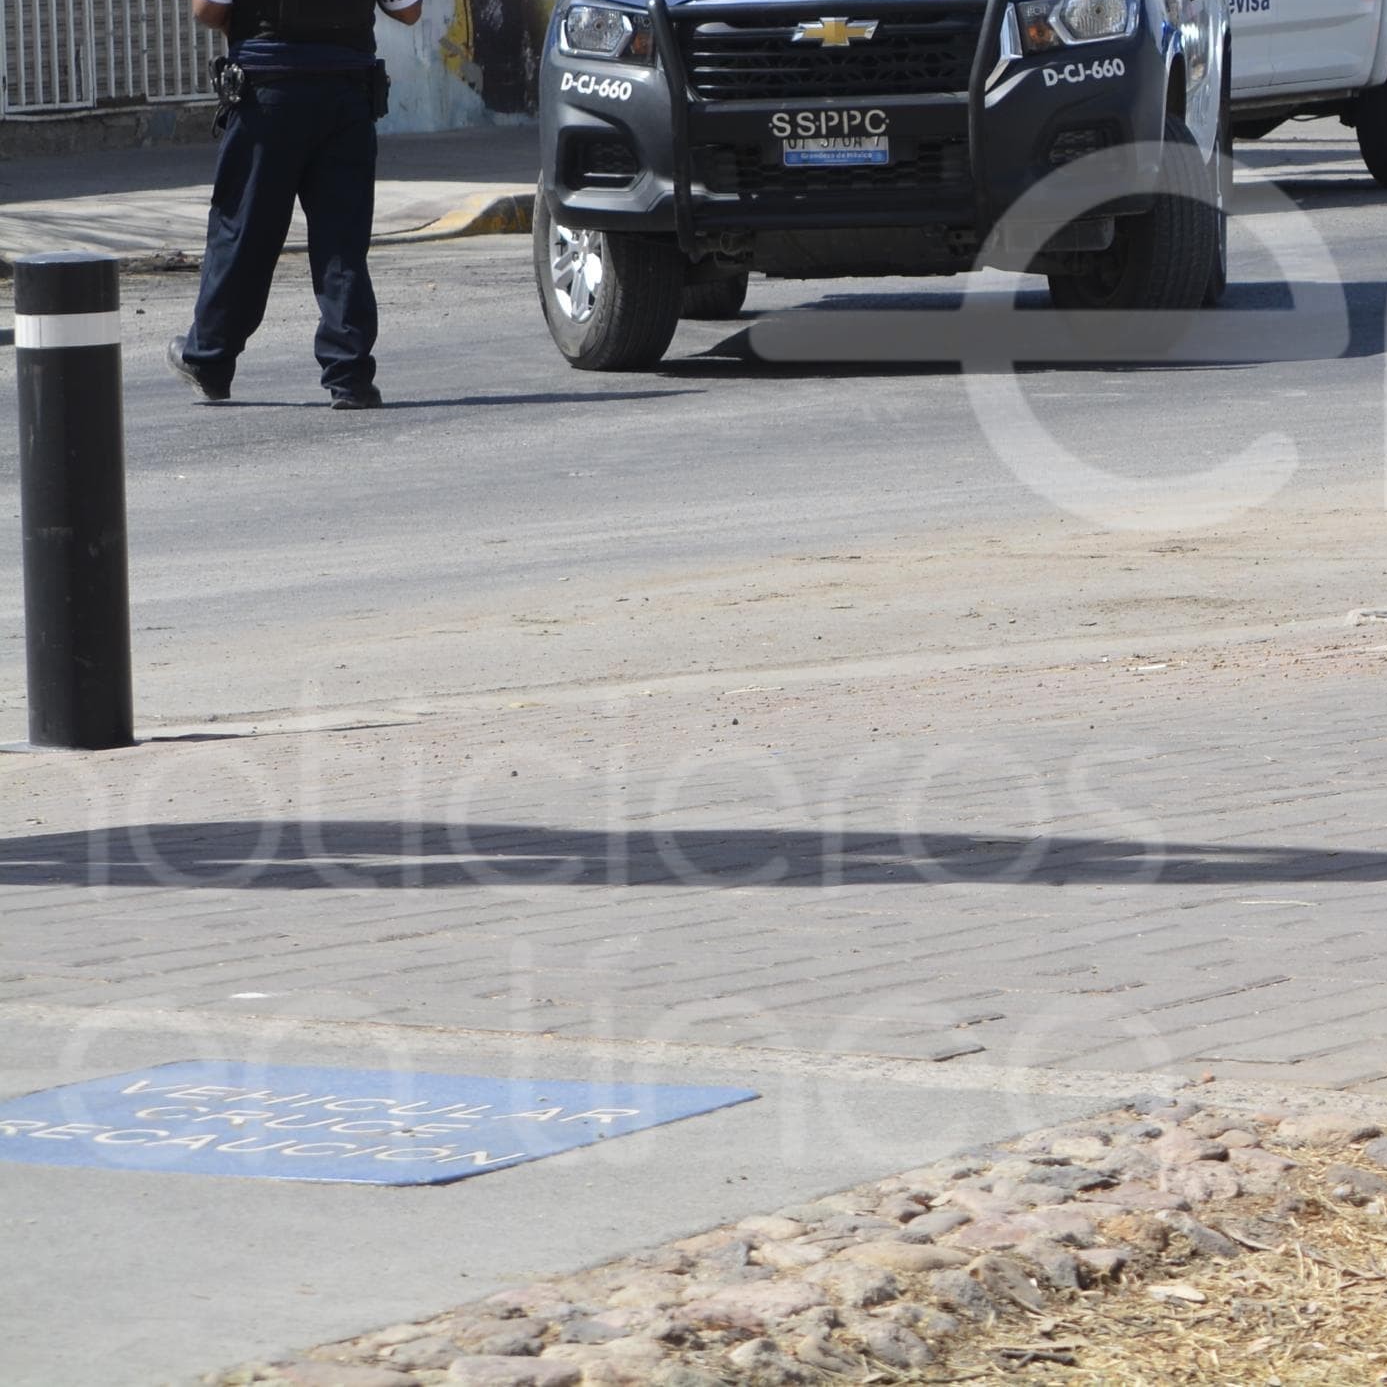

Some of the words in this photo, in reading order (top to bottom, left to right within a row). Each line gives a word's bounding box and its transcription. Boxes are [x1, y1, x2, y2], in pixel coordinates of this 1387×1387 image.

[559, 71, 632, 101] D-CJ-660
[1042, 58, 1126, 87] D-CJ-660
[771, 109, 887, 137] SSPPC
[119, 1079, 642, 1125] VEHICULAR
[134, 1105, 471, 1139] CRUCE
